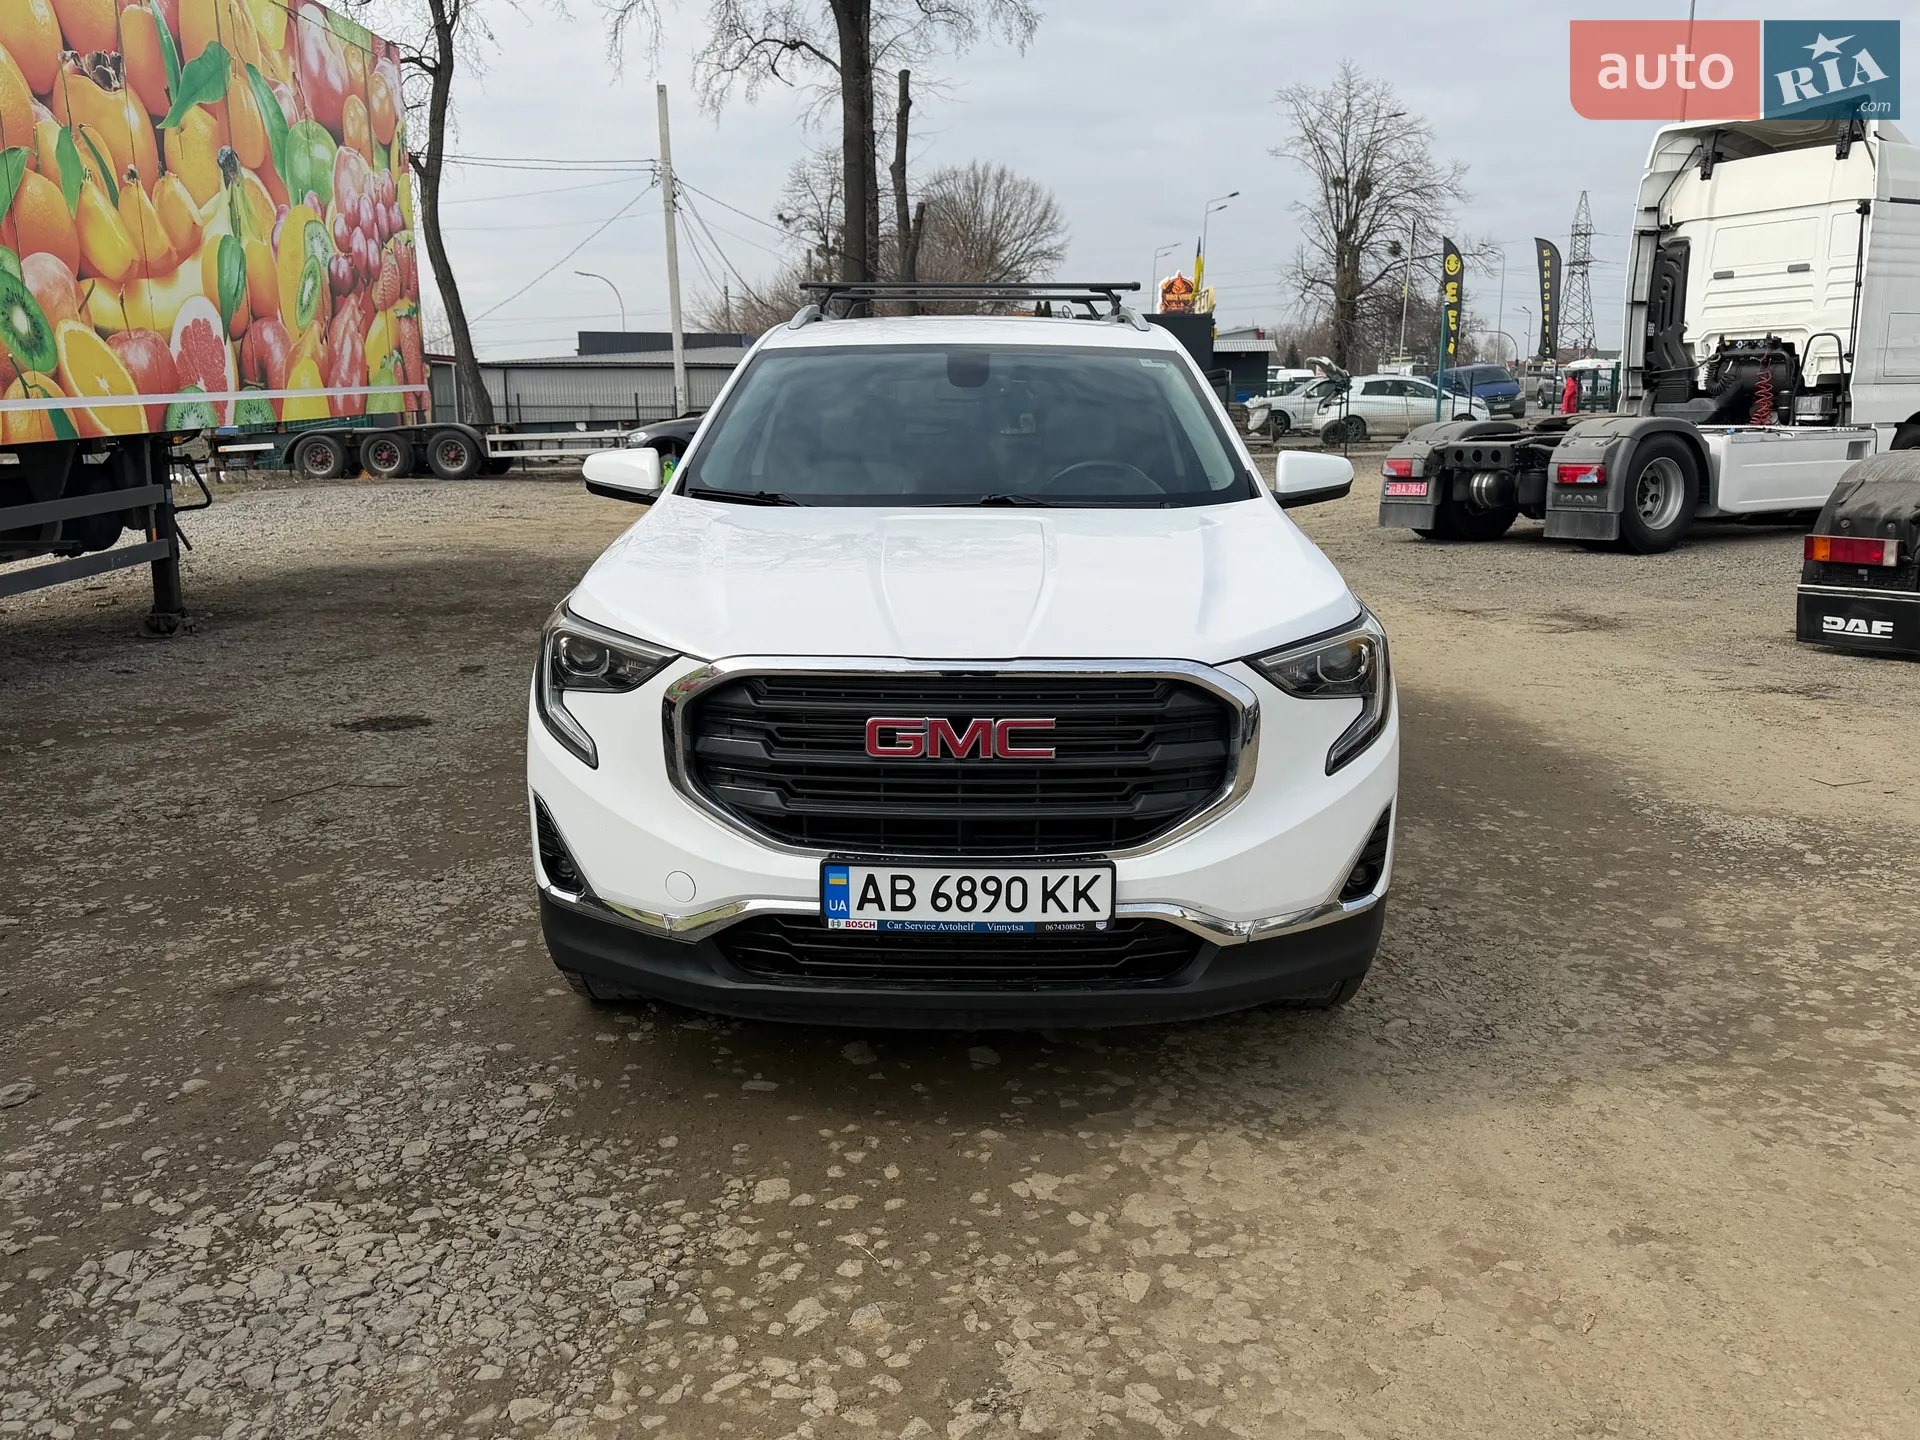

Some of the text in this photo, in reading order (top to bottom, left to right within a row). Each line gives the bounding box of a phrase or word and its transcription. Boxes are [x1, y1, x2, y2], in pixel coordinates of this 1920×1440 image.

[1560, 494, 1597, 502] MAN
[1822, 615, 1894, 635] DAF
[866, 717, 1056, 759] GMC
[856, 874, 1101, 913] AB 6890 KK
[829, 900, 847, 911] UA
[845, 921, 876, 929] BOSCH
[887, 921, 902, 930] Car
[904, 922, 936, 931] Service
